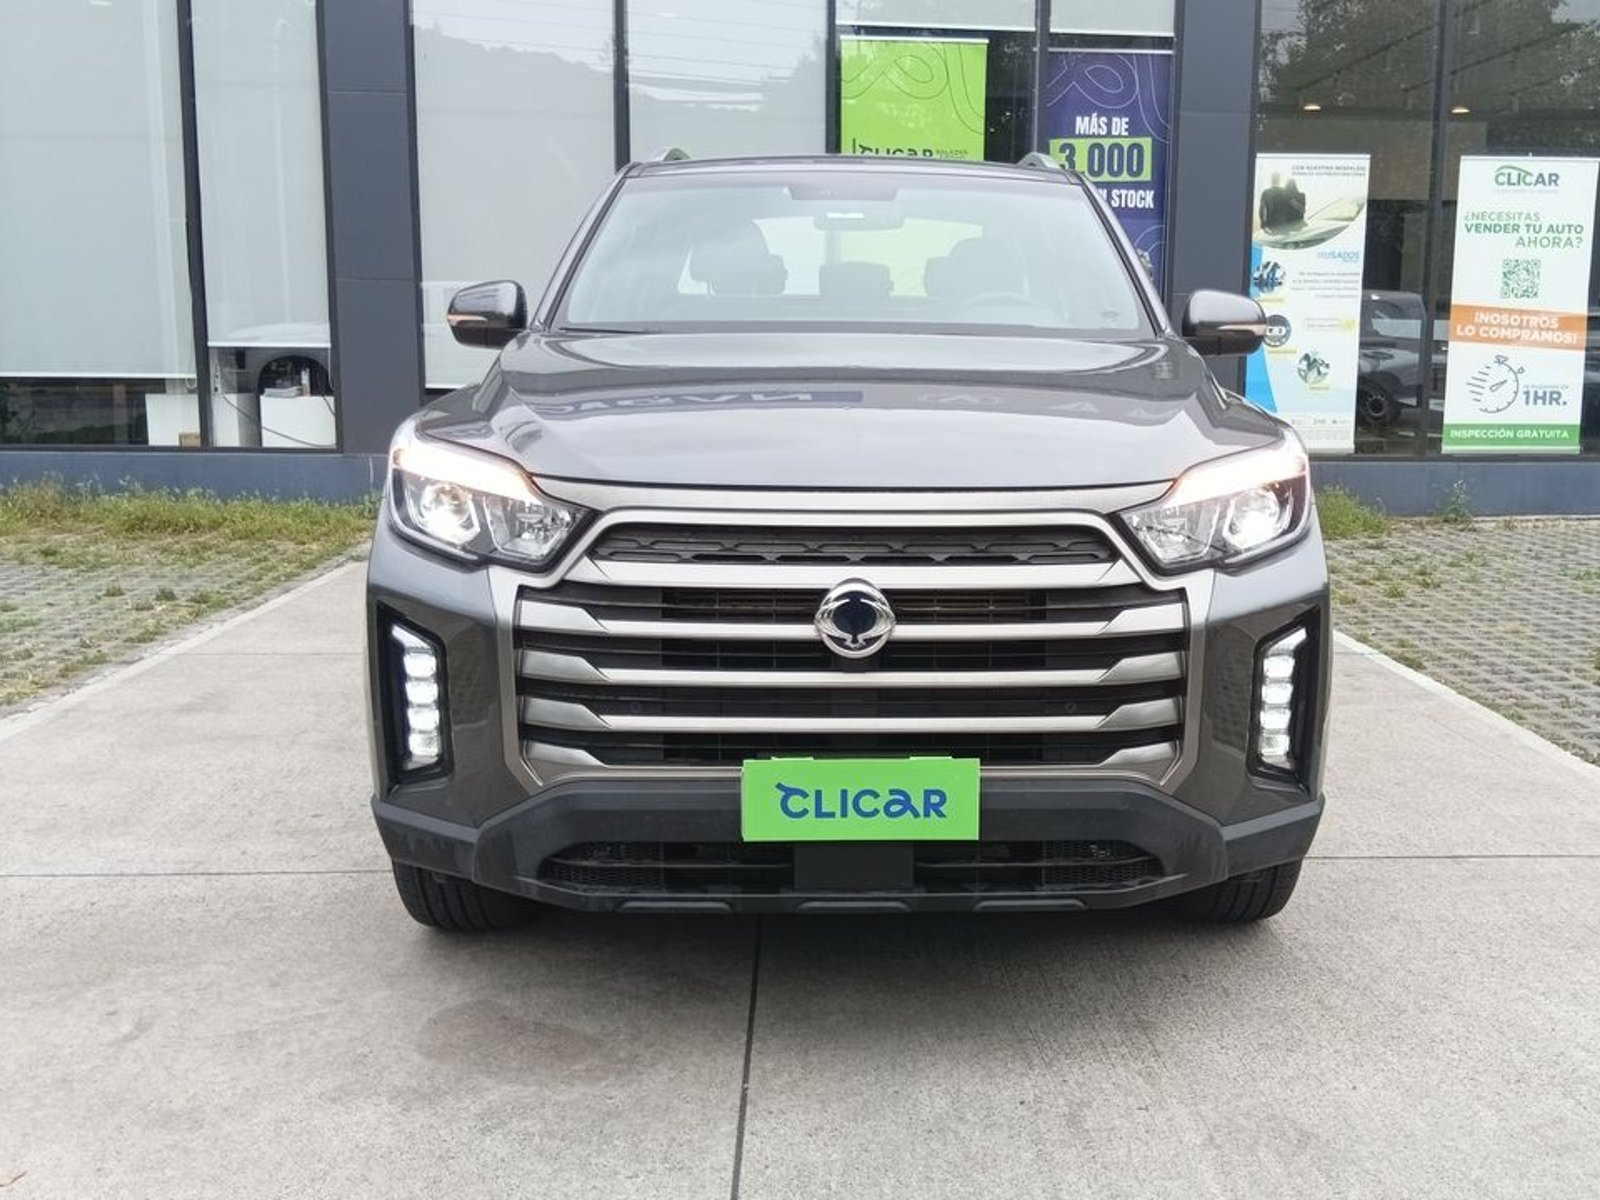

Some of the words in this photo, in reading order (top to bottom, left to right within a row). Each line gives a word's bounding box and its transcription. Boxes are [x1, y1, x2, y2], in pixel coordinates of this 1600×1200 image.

[1075, 112, 1108, 135] MÁS
[1111, 117, 1129, 136] DE
[1059, 142, 1145, 178] 3000
[1494, 165, 1559, 187] CLICAR
[1111, 188, 1154, 208] STOCK
[1464, 211, 1541, 223] ¿NECESITAS
[1464, 223, 1521, 235] VENDER
[1525, 224, 1542, 235] TU
[1546, 224, 1584, 235] AUTO
[1515, 236, 1583, 249] AHORA?
[1456, 324, 1476, 336] LO
[1479, 326, 1578, 344] COMPRAMOS!
[1450, 428, 1514, 439] INSPECCIÓN
[1516, 429, 1570, 439] GRATUITA
